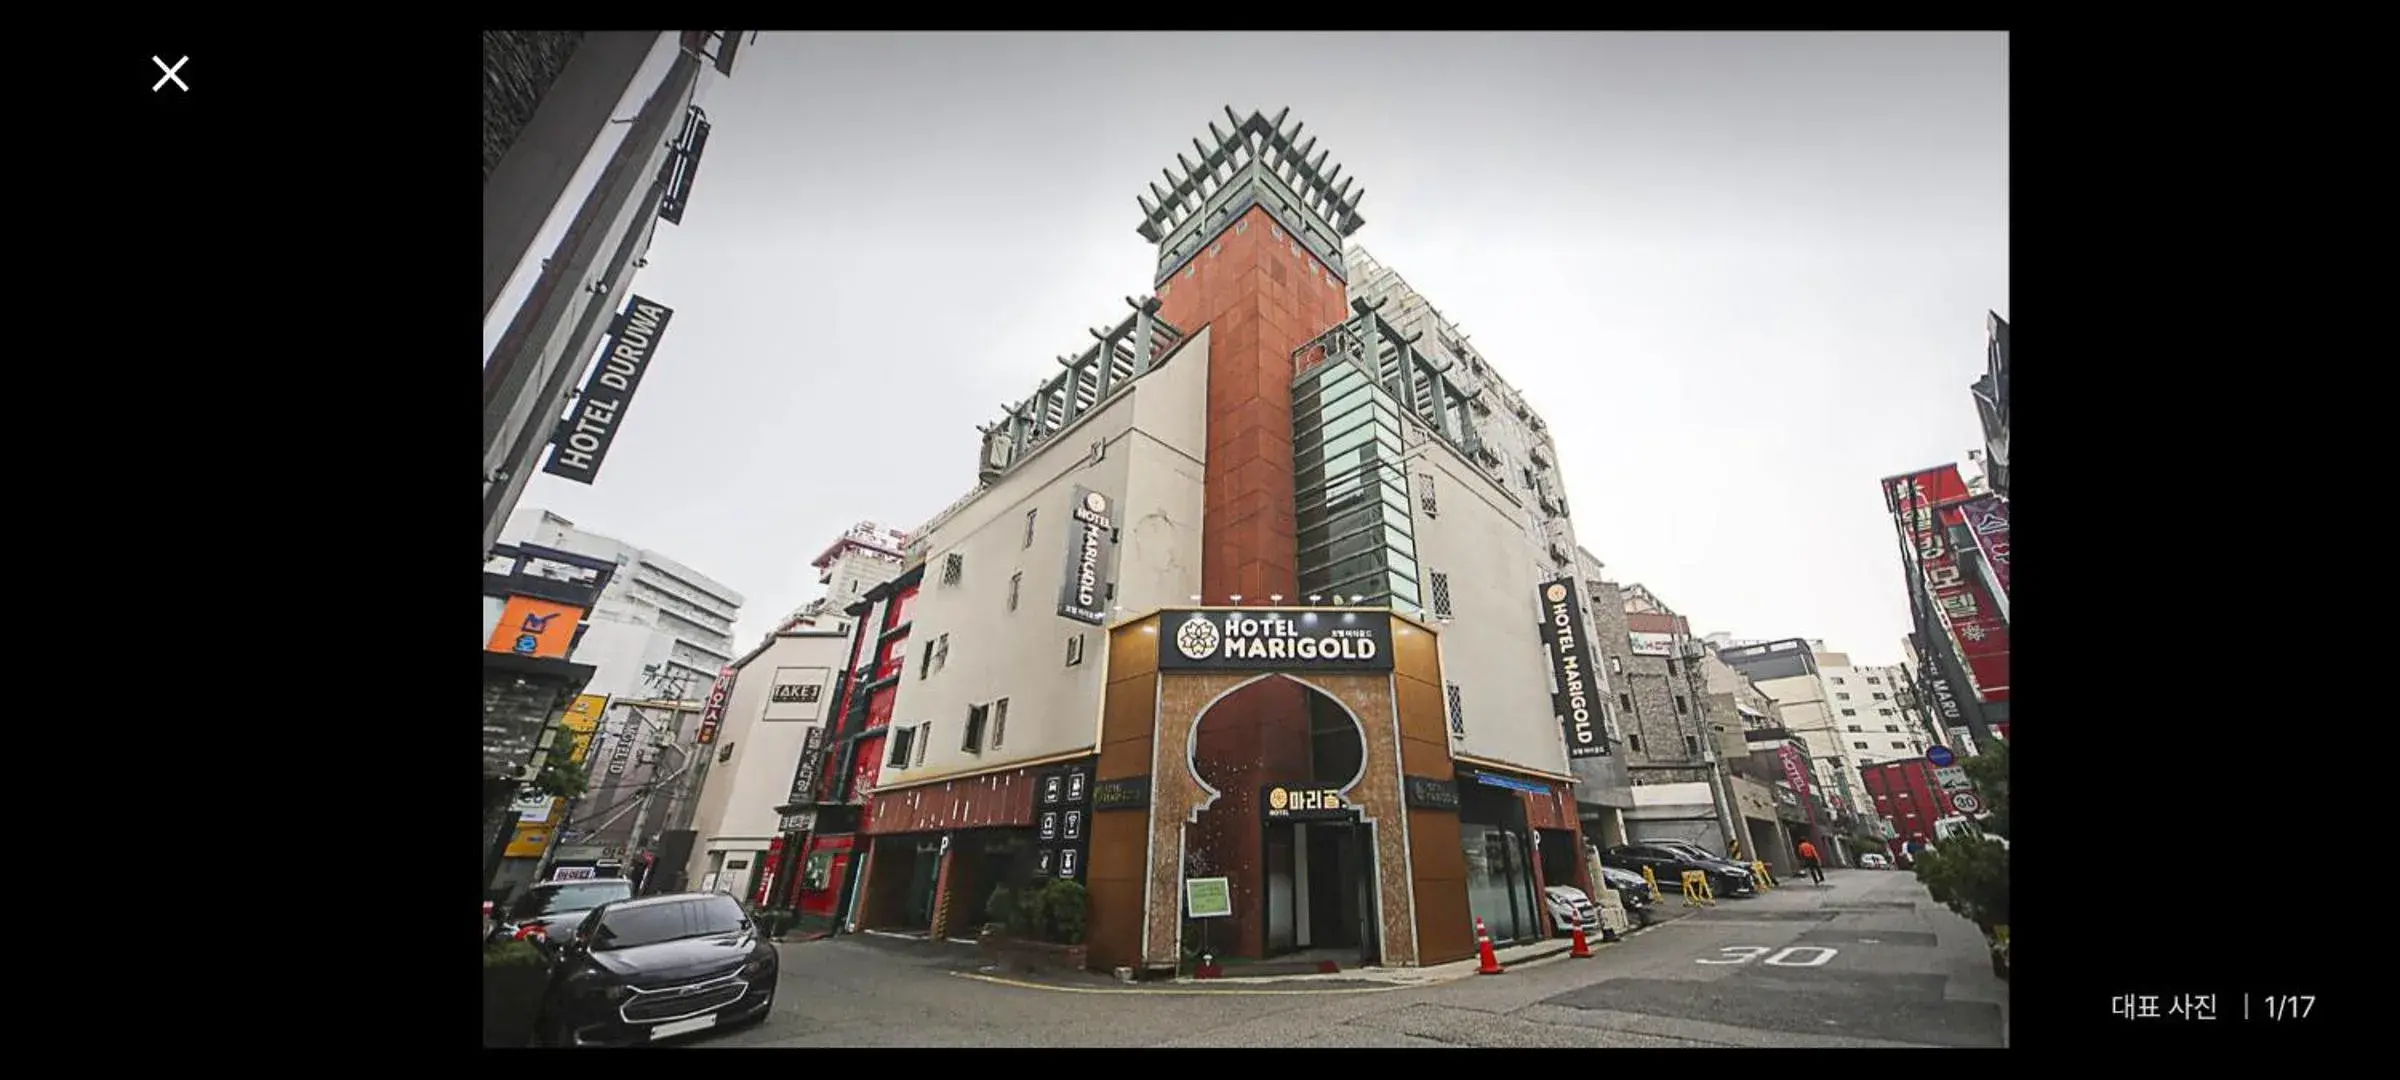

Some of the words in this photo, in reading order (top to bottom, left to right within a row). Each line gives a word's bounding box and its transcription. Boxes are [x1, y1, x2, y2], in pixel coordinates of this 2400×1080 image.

[560, 399, 619, 469] HOTEL
[600, 303, 665, 391] DURUWA
[1077, 507, 1110, 530] HOTEL
[1079, 524, 1100, 606] MARIGOLD
[1224, 619, 1299, 637] HOTEL
[1552, 603, 1576, 653] HOTEL
[1224, 638, 1376, 659] MARIGOLD
[1562, 655, 1593, 743] MARIGOLD
[1932, 679, 1961, 720] MARU
[1956, 796, 1976, 808] 30
[1695, 946, 1838, 967] 30
